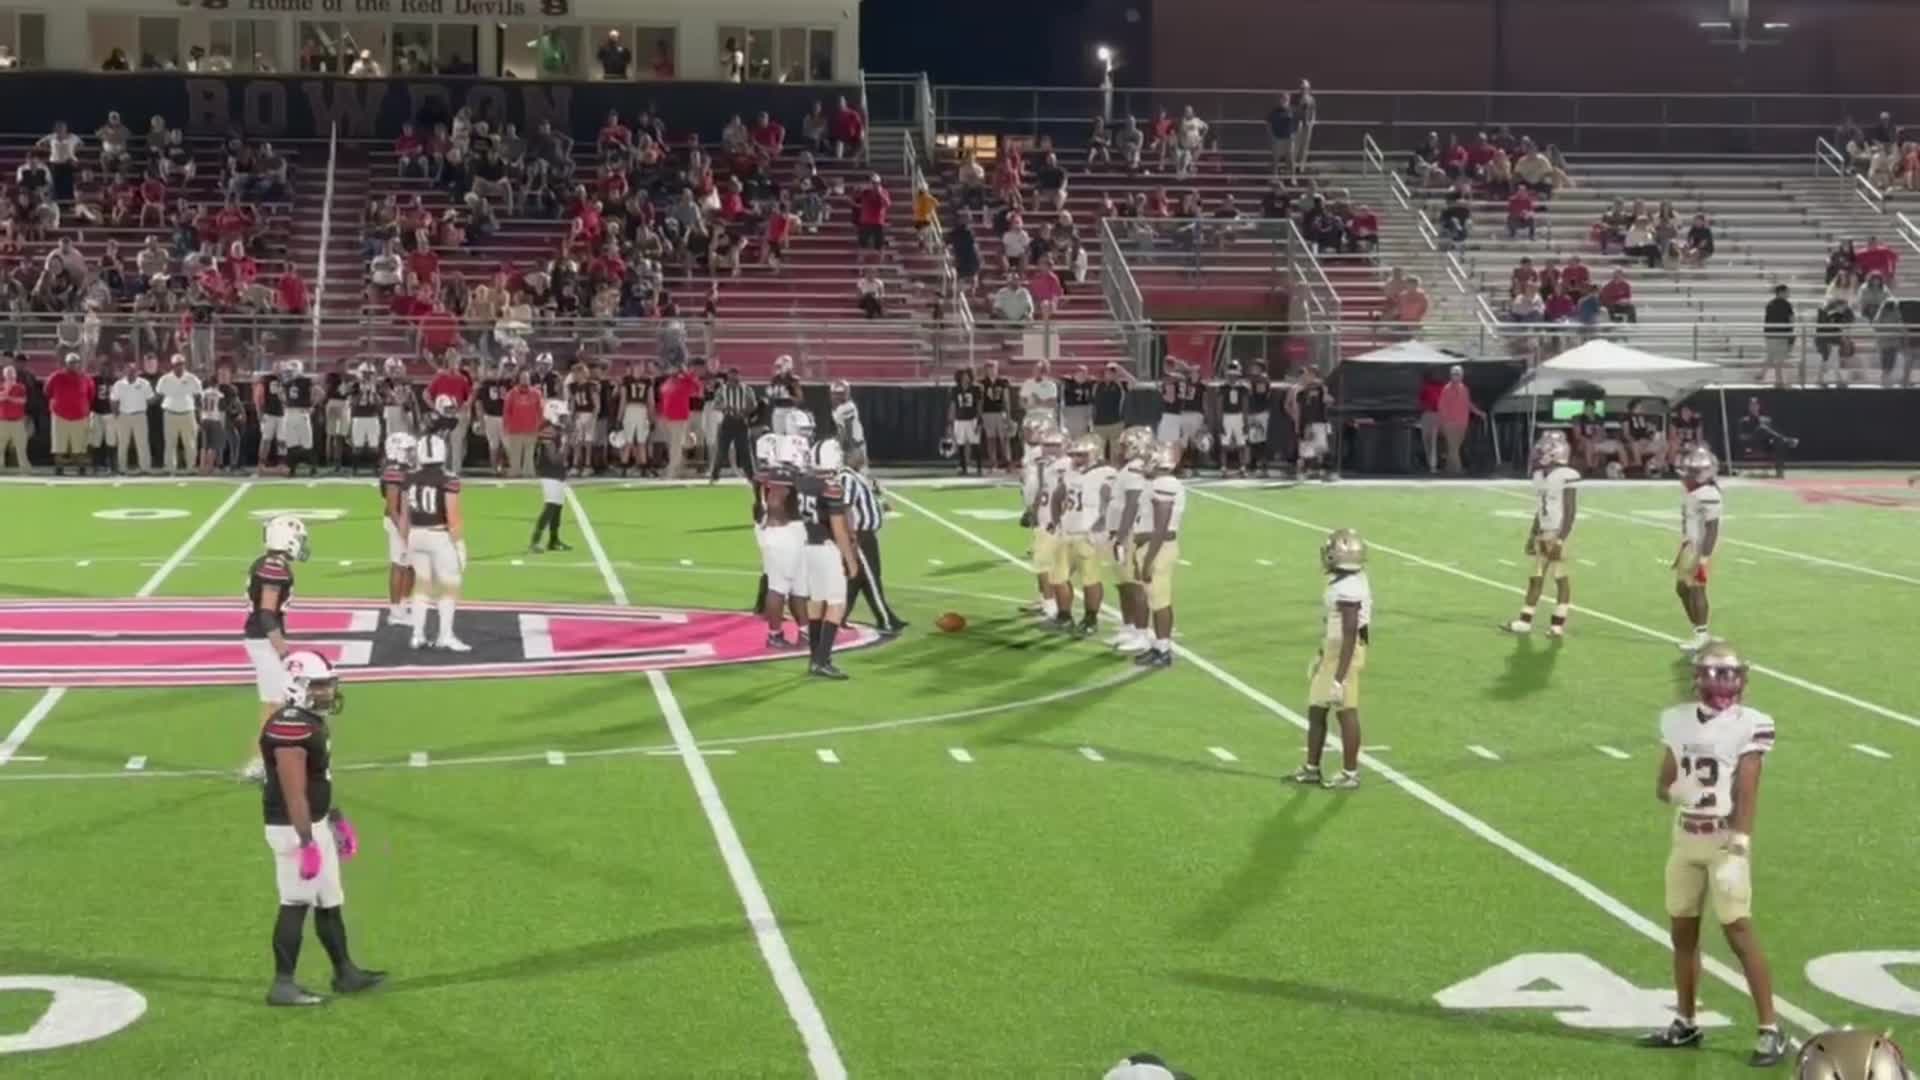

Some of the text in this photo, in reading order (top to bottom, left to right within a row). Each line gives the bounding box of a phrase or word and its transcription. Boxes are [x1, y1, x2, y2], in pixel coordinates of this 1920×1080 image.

[247, 0, 524, 15] Home of the Red Devils
[185, 80, 573, 137] BOWDON
